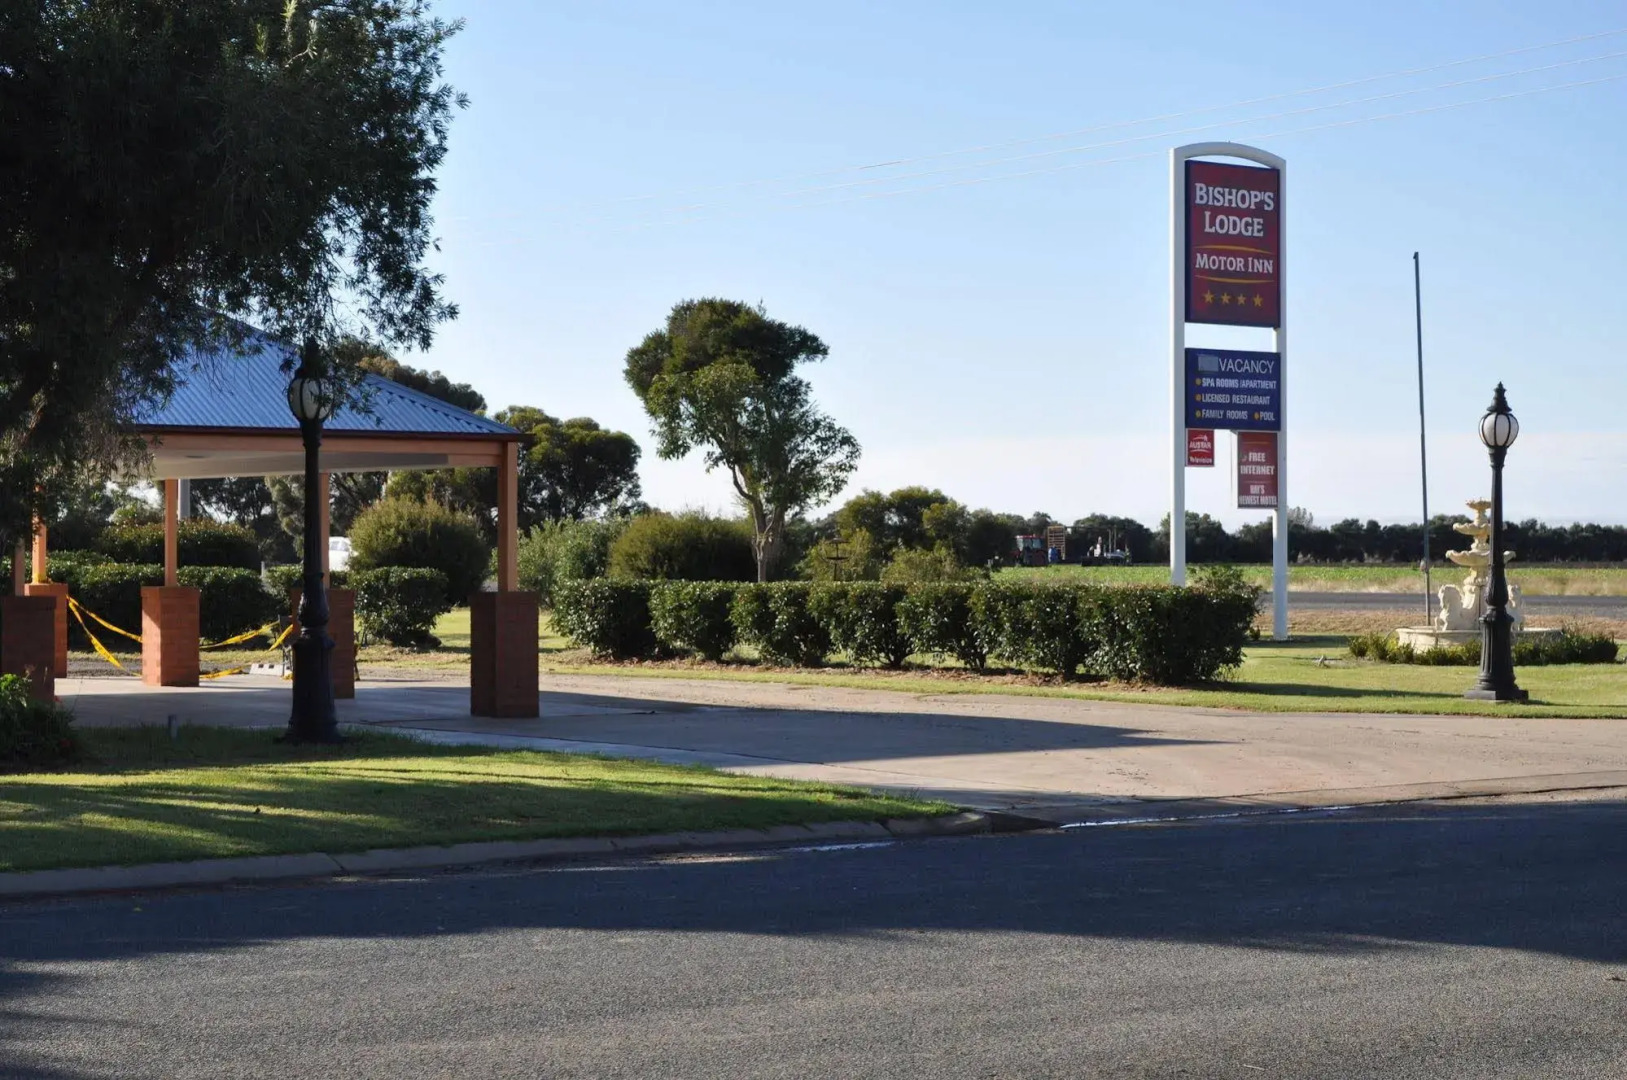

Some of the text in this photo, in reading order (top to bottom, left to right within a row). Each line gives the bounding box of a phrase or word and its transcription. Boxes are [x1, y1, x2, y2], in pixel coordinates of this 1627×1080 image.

[1195, 183, 1274, 210] BISHOP'S
[1204, 211, 1264, 237] LODGE
[1195, 253, 1274, 274] MOTOR INN
[1219, 358, 1274, 373] VACANCY
[1202, 377, 1215, 388] SPA
[1215, 378, 1239, 389] ROOMS
[1202, 393, 1270, 404] LICENSED RESTAURANT
[1202, 409, 1276, 421] FAMILY ROOMS POOL
[1248, 451, 1266, 463] FREE
[1240, 465, 1275, 475] INTERNET
